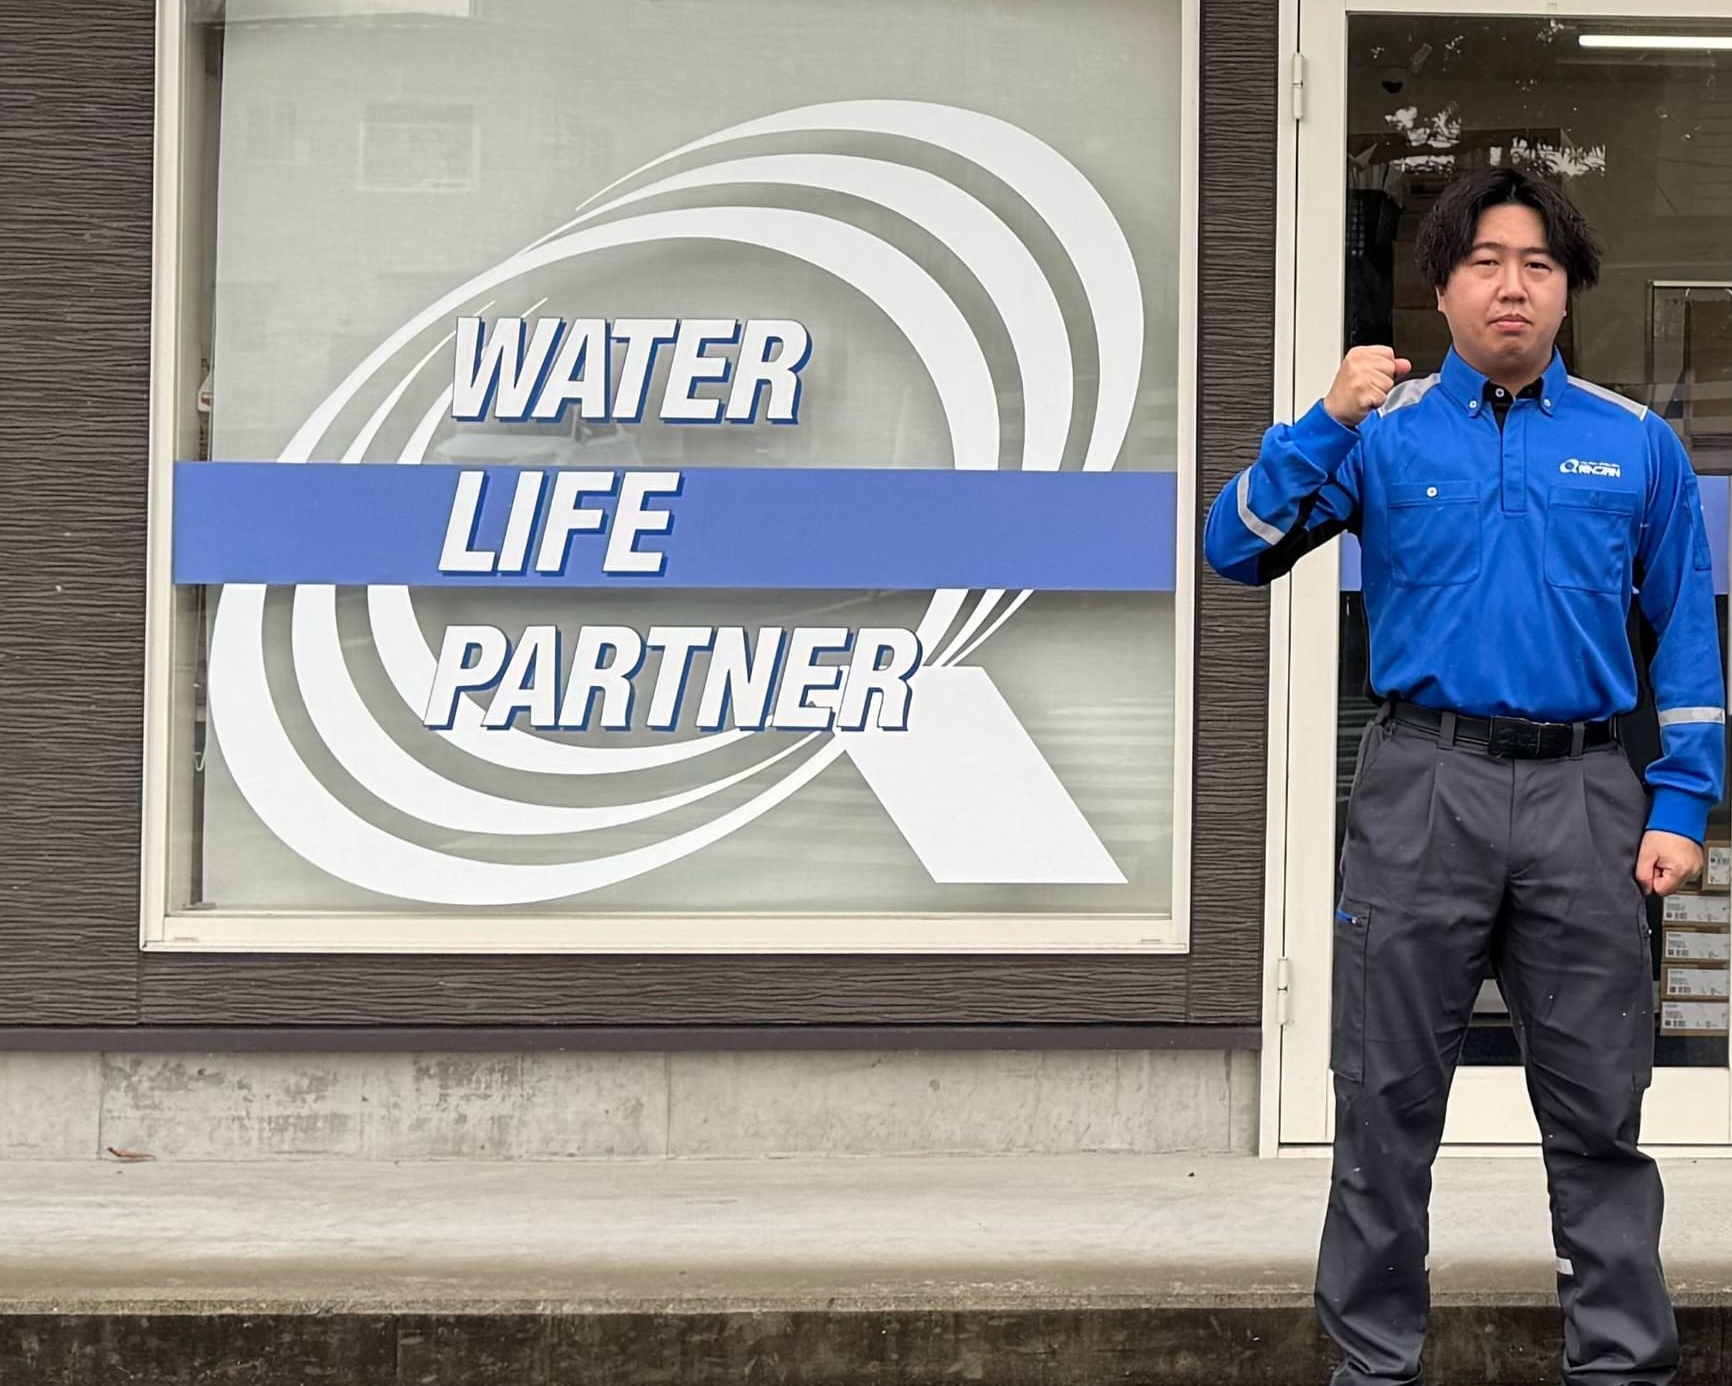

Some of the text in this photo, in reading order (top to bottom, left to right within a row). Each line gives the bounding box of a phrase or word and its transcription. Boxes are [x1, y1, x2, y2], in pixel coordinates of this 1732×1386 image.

[451, 317, 813, 424] WATER
[437, 471, 684, 576] LIFE
[423, 624, 922, 732] PARTNER
